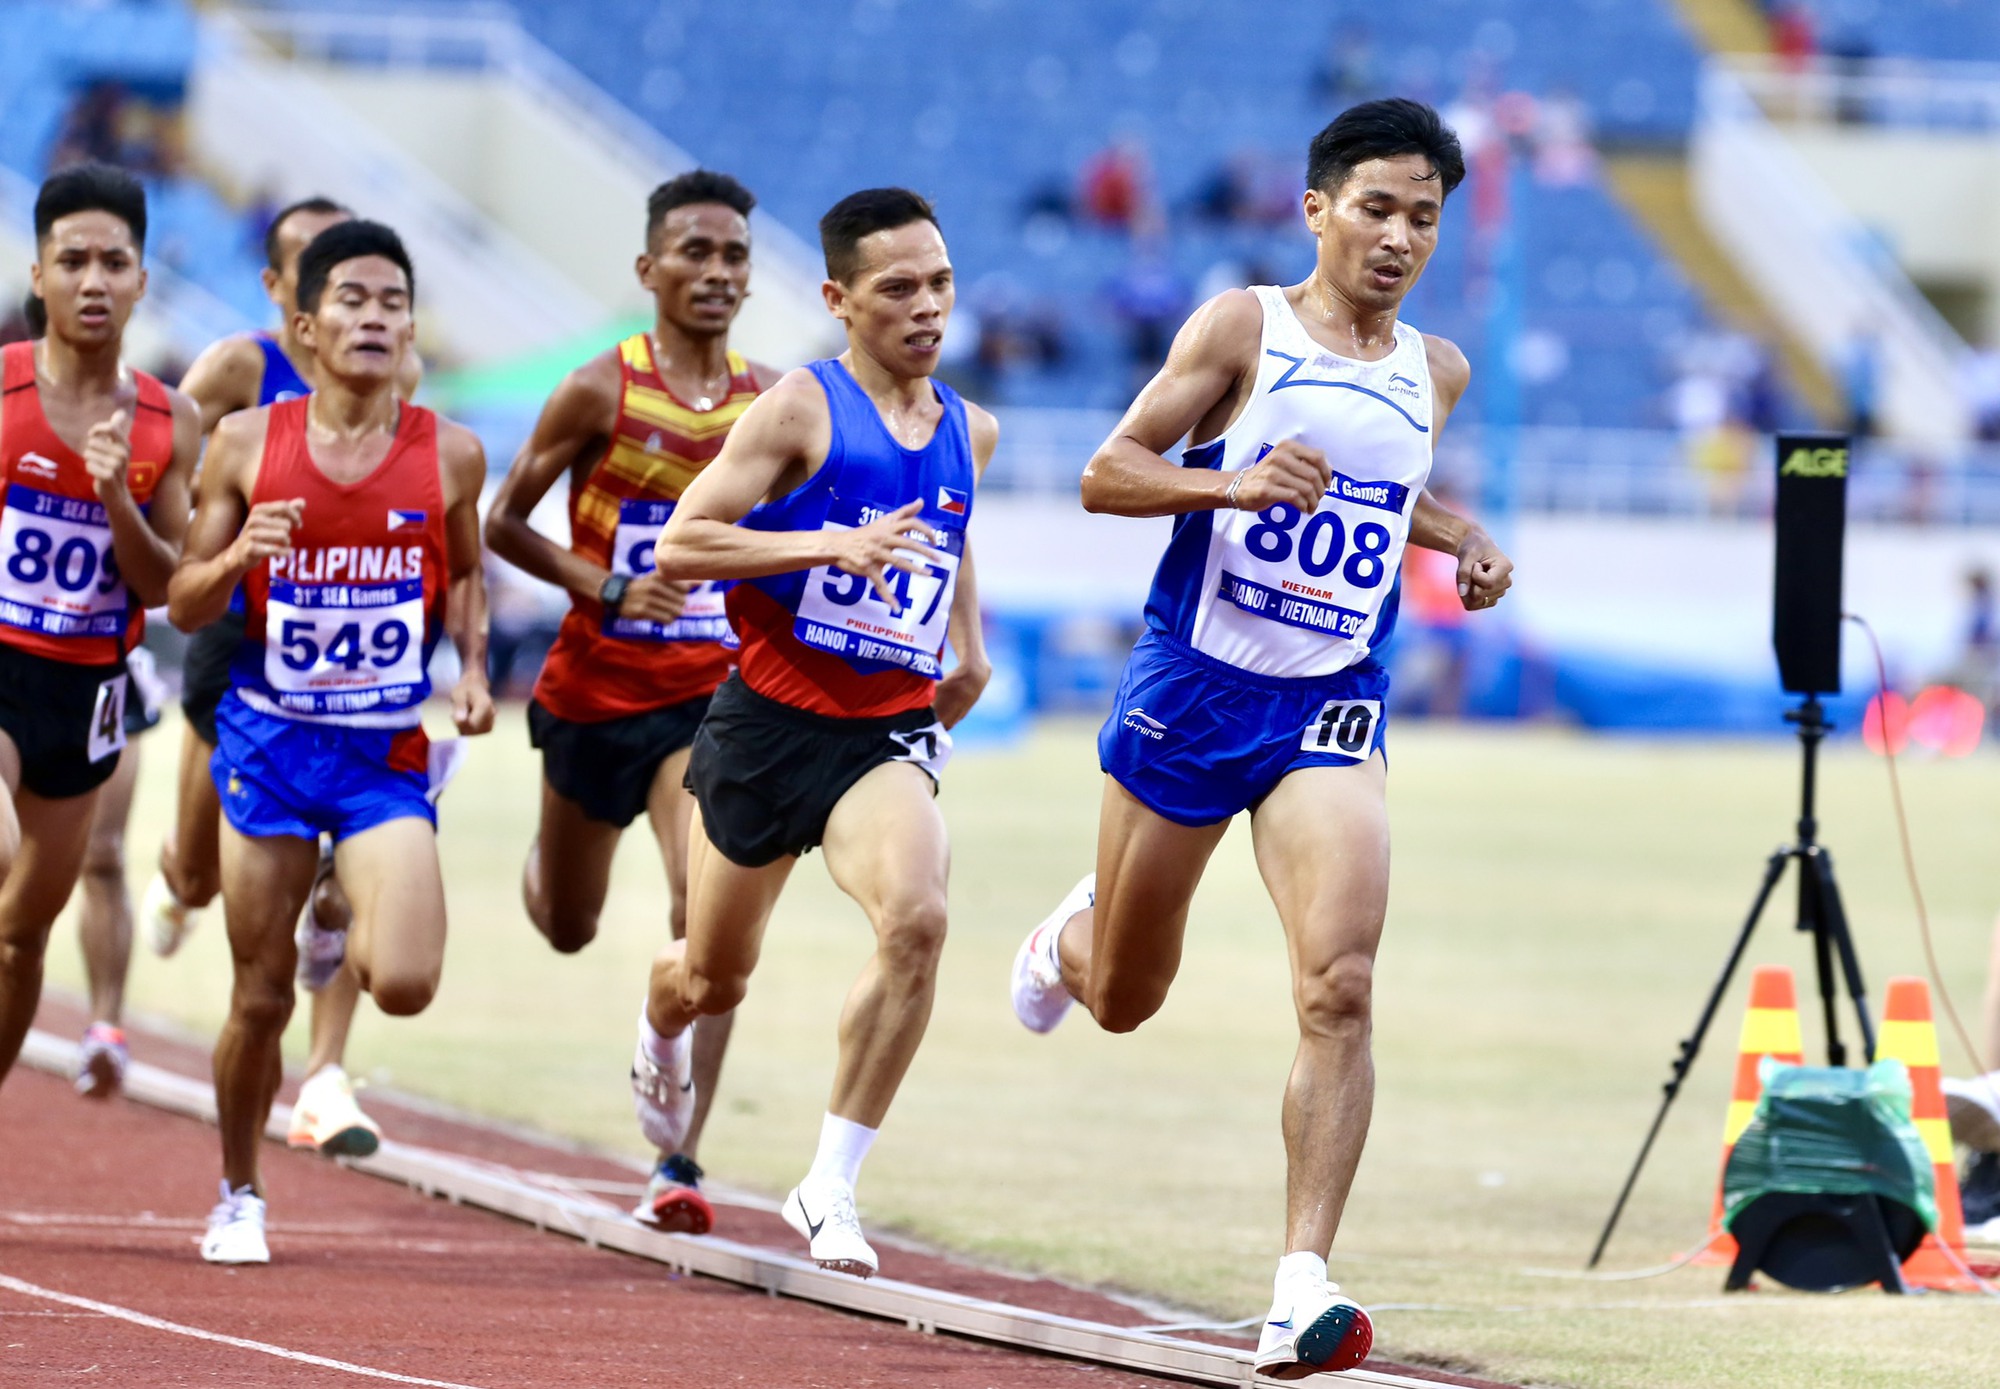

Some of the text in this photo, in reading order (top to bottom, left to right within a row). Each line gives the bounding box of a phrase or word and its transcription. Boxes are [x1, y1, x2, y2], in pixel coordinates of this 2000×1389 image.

[1341, 480, 1389, 504] Games
[269, 546, 423, 581] PILIPINAS
[1244, 502, 1391, 589] 808
[321, 585, 349, 607] SEA
[350, 586, 398, 607] Games
[1281, 579, 1333, 600] VIETNAM
[846, 618, 915, 643] PHILIPPINES
[1279, 597, 1339, 631] VIETNAM
[1338, 614, 1365, 636] 20
[280, 619, 410, 672] 549
[804, 624, 848, 651] HANOI
[856, 639, 913, 667] VIETNAM
[97, 683, 118, 744] 4
[1123, 716, 1165, 740] LI-NING
[1317, 704, 1373, 752] 10
